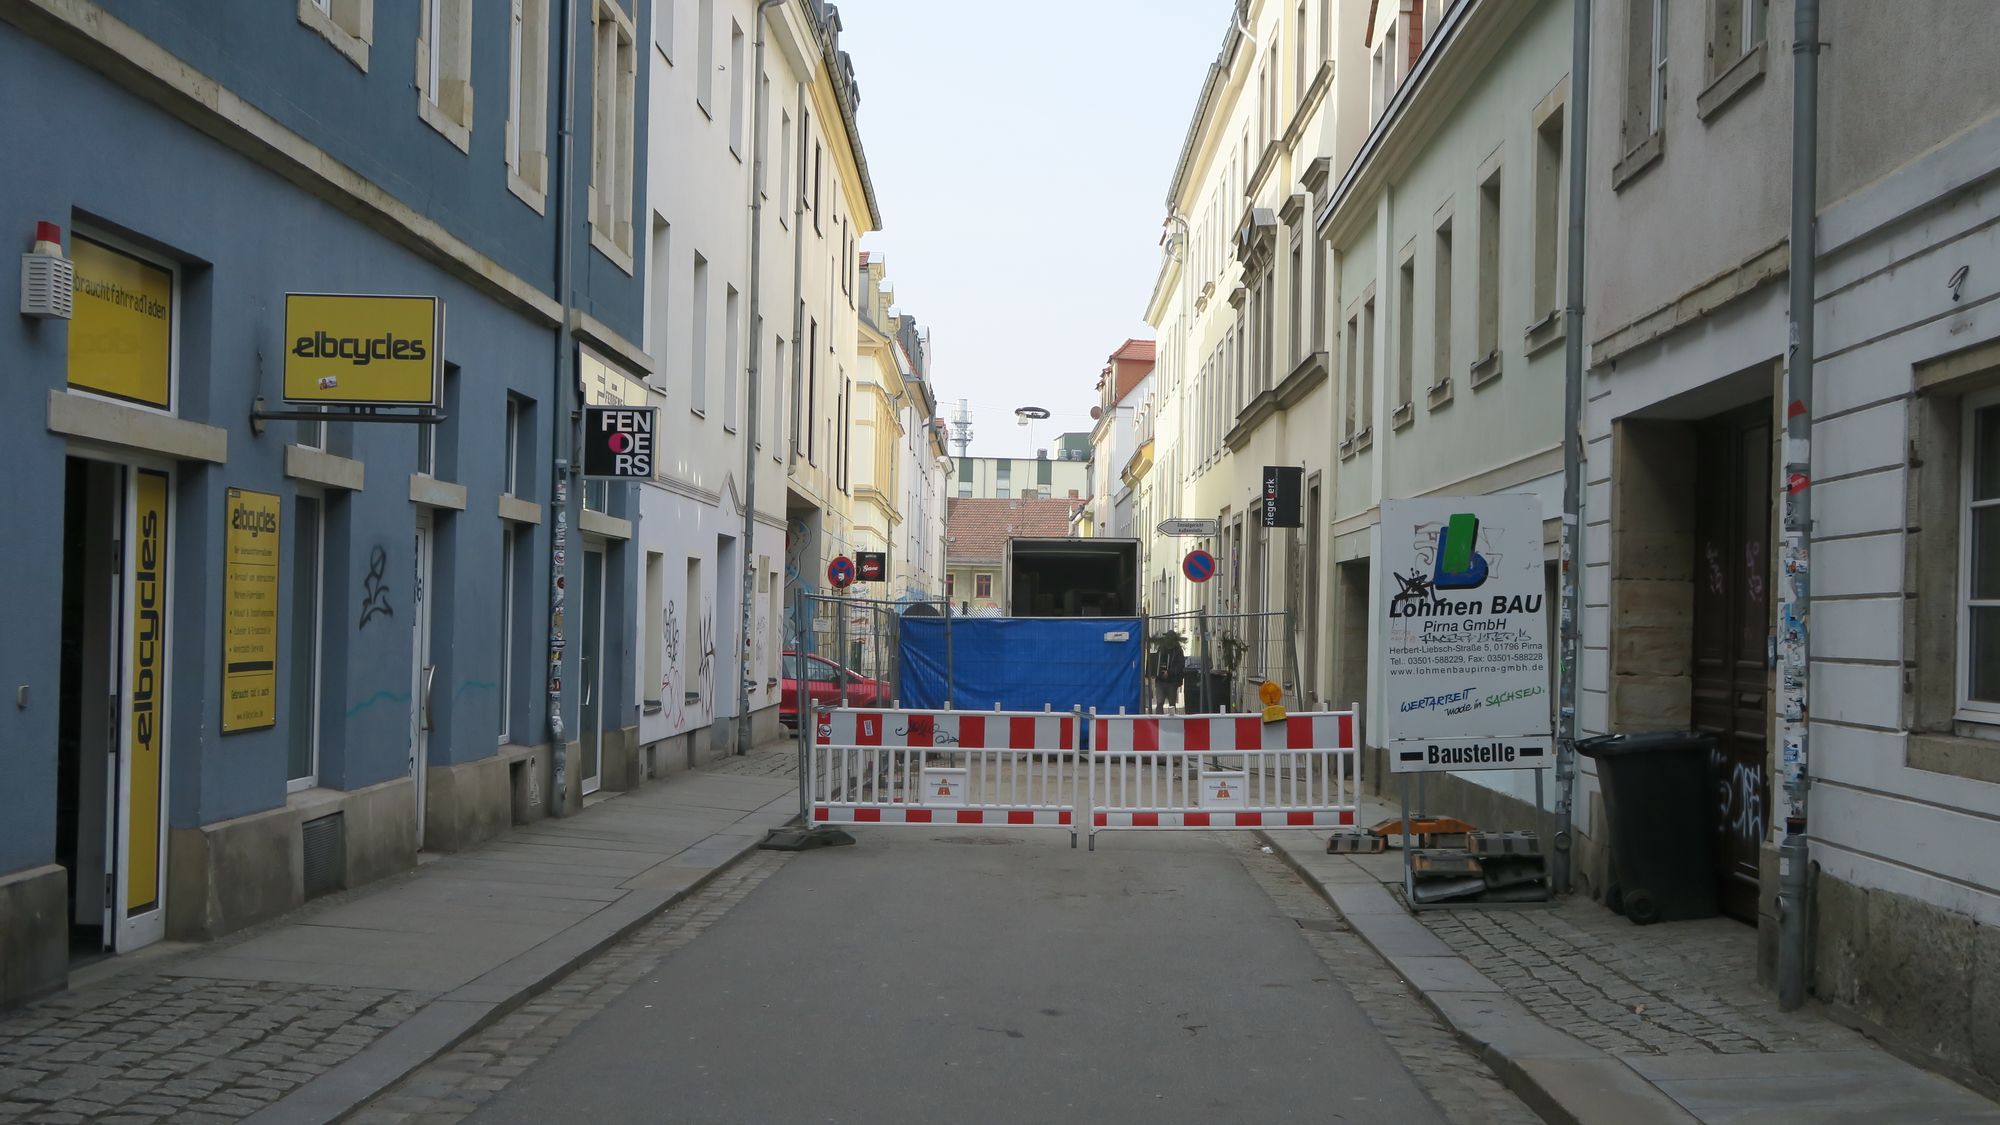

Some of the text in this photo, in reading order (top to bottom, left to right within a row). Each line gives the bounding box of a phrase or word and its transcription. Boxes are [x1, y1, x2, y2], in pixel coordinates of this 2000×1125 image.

[73, 271, 166, 320] brauchtfahrradladen
[292, 331, 426, 366] elbcycles
[232, 503, 276, 538] elbcycles
[1389, 594, 1542, 618] Lohmen BAU
[134, 510, 159, 751] elbcycles
[1423, 618, 1506, 632] Pirna GmbH
[1389, 642, 1543, 655] Herbert-Liebsch-Straße 5, 01796 Pirna
[1468, 654, 1484, 663] Fax:
[1487, 653, 1543, 662] 03501-588228
[1390, 664, 1544, 676] www.lohmenbaupirna-gmbh.de
[1401, 687, 1477, 712] WERTARBEIT
[1444, 702, 1472, 716] made
[1473, 699, 1482, 710] in
[1428, 743, 1515, 765] Baustelle
